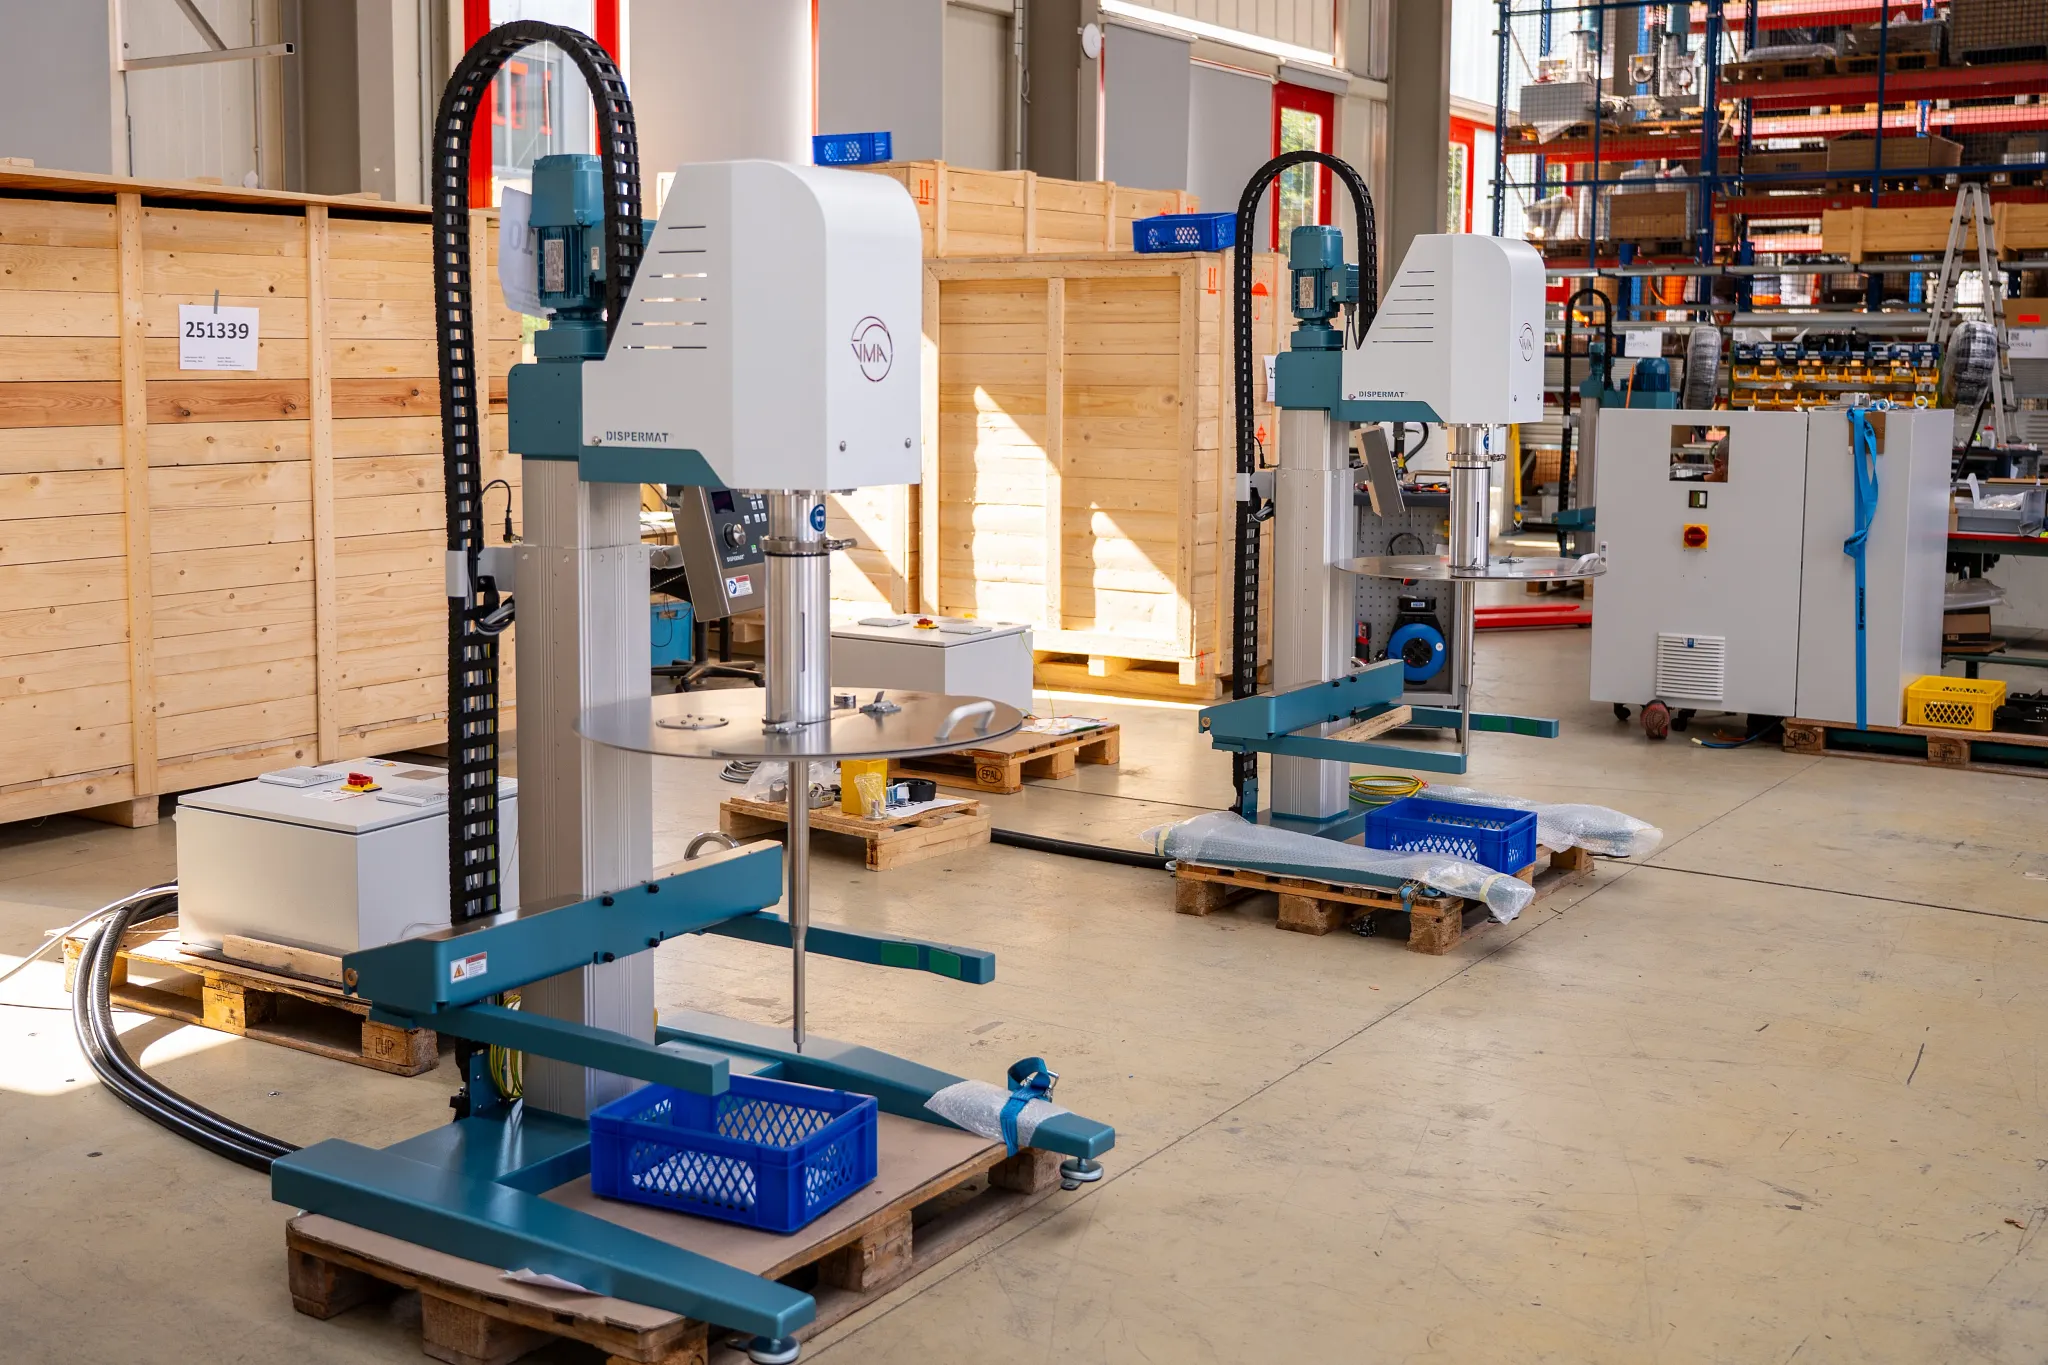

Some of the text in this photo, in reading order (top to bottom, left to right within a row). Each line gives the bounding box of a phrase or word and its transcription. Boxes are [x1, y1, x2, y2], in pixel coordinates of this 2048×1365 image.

[185, 321, 249, 339] 251339
[1358, 390, 1405, 398] DISPERMAT
[605, 431, 669, 443] DISPERMAT
